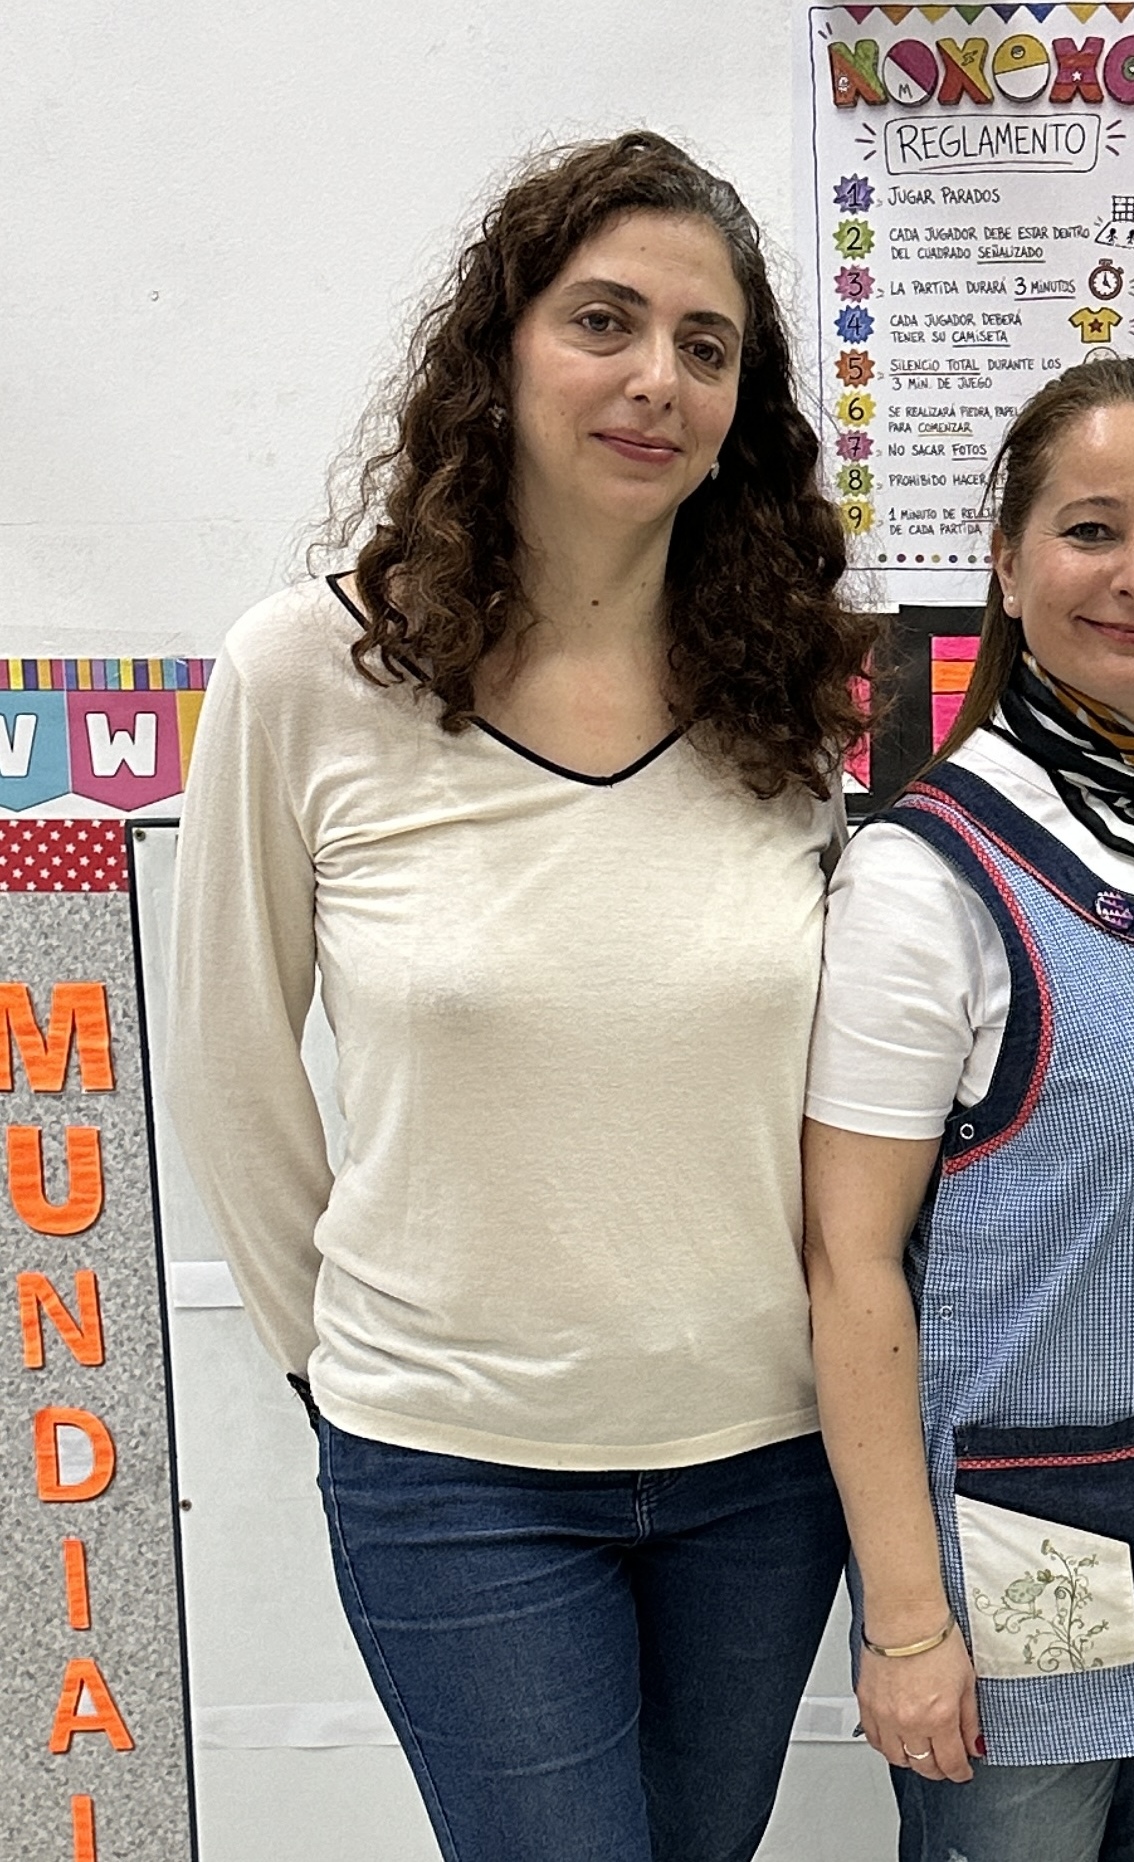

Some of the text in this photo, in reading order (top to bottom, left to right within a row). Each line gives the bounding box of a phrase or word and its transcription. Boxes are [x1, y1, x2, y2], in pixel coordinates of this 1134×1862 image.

[896, 122, 1086, 163] REGLAMENTO
[847, 183, 1001, 207] 1 JUGAR PARADOS
[846, 226, 1090, 251] 2 CADA JUGADOR DEBE ESTAR DENTRO
[891, 244, 1044, 260] DEL CUADRADO SEÑALIZADO
[847, 272, 1076, 296] 3 LA PARTIDA DURARÁ 3 MINUTOS
[846, 308, 1022, 336] 4 CADA JUGADOR DEBERÁ
[891, 330, 1008, 343] TENER SU CAMISETA
[849, 357, 1061, 381] 5 SILENCIO TOTAL DURANTE LOS
[891, 379, 902, 391] 3
[938, 378, 951, 389] DE
[957, 377, 993, 389] JUEGO
[848, 397, 864, 421] 6
[888, 406, 900, 417] SE
[905, 403, 956, 417] REALIZARÁ
[888, 421, 973, 433] PARA COMENZAR
[848, 436, 987, 458] 7 NO SACAR FOTOS
[848, 469, 863, 491] 8
[889, 473, 947, 486] PROHIBIDO
[953, 474, 986, 486] HACER
[848, 506, 862, 529] 9
[889, 508, 896, 521] 1
[901, 508, 937, 521] MINUTO
[943, 508, 956, 519] DE
[889, 522, 982, 535] DE CADA PARTIDA
[85, 711, 158, 778] W
